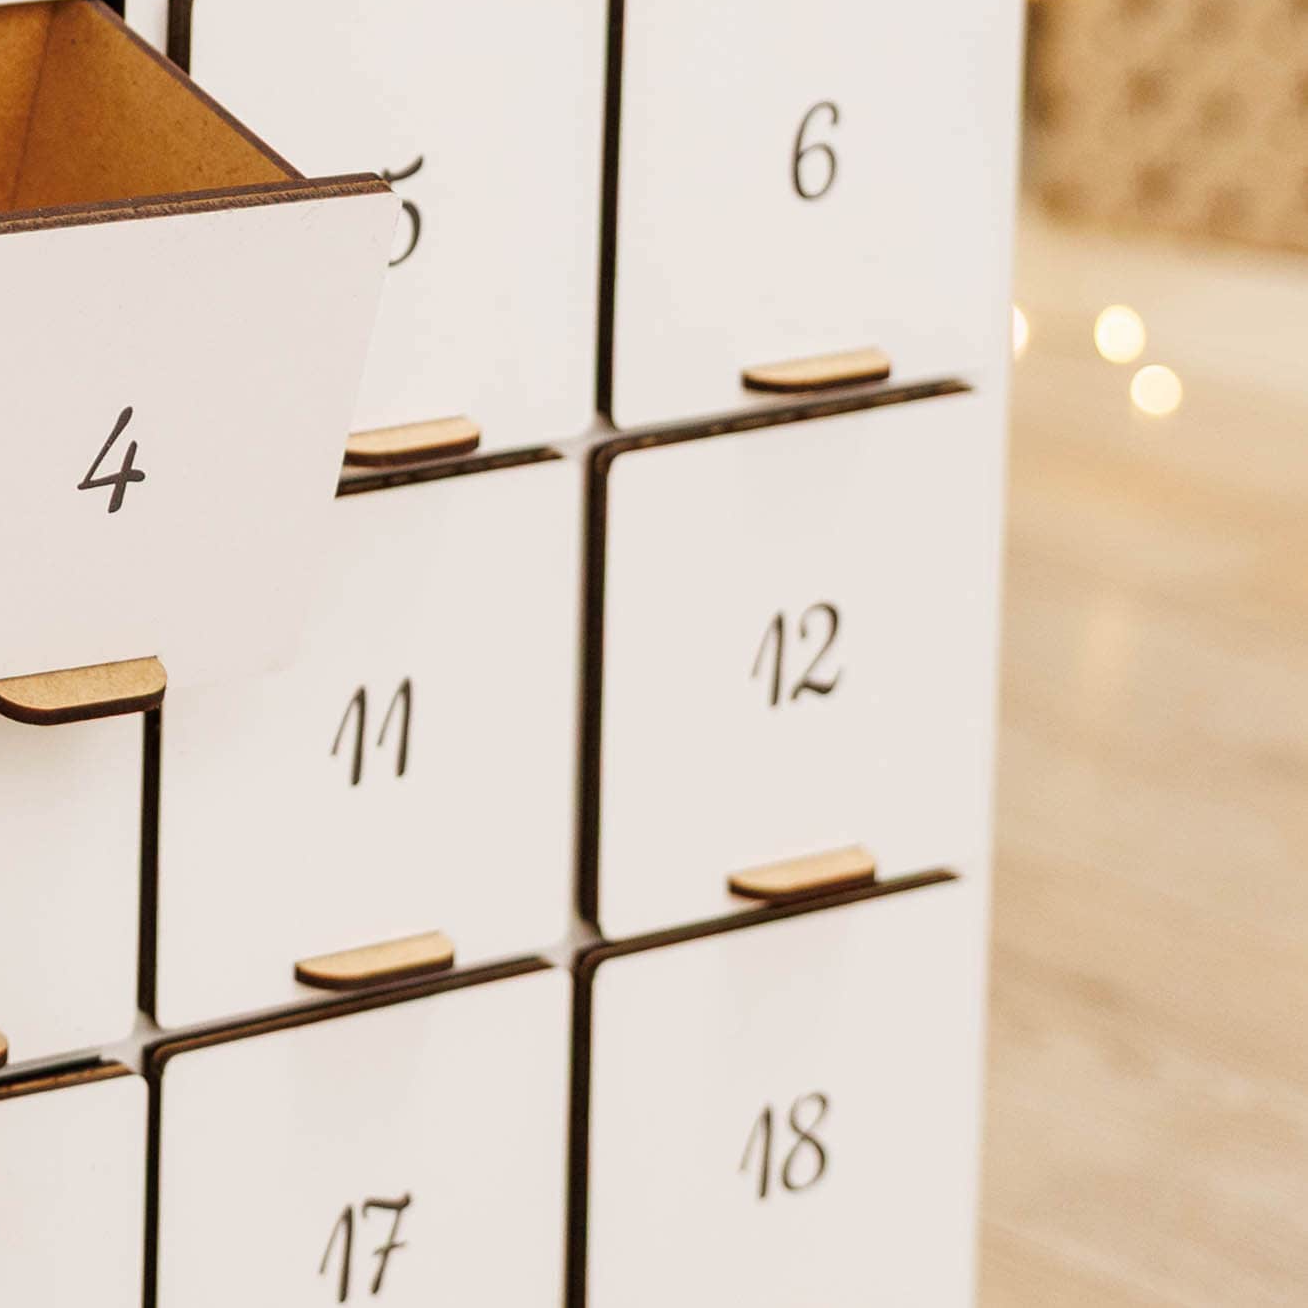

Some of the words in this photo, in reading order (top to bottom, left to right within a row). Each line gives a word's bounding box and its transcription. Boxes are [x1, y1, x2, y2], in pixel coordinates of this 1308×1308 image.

[790, 100, 840, 202] 6
[77, 406, 146, 514] 4
[752, 602, 840, 707] 12
[330, 676, 414, 787] 11
[740, 1092, 829, 1200] 18
[318, 1192, 414, 1305] 17
